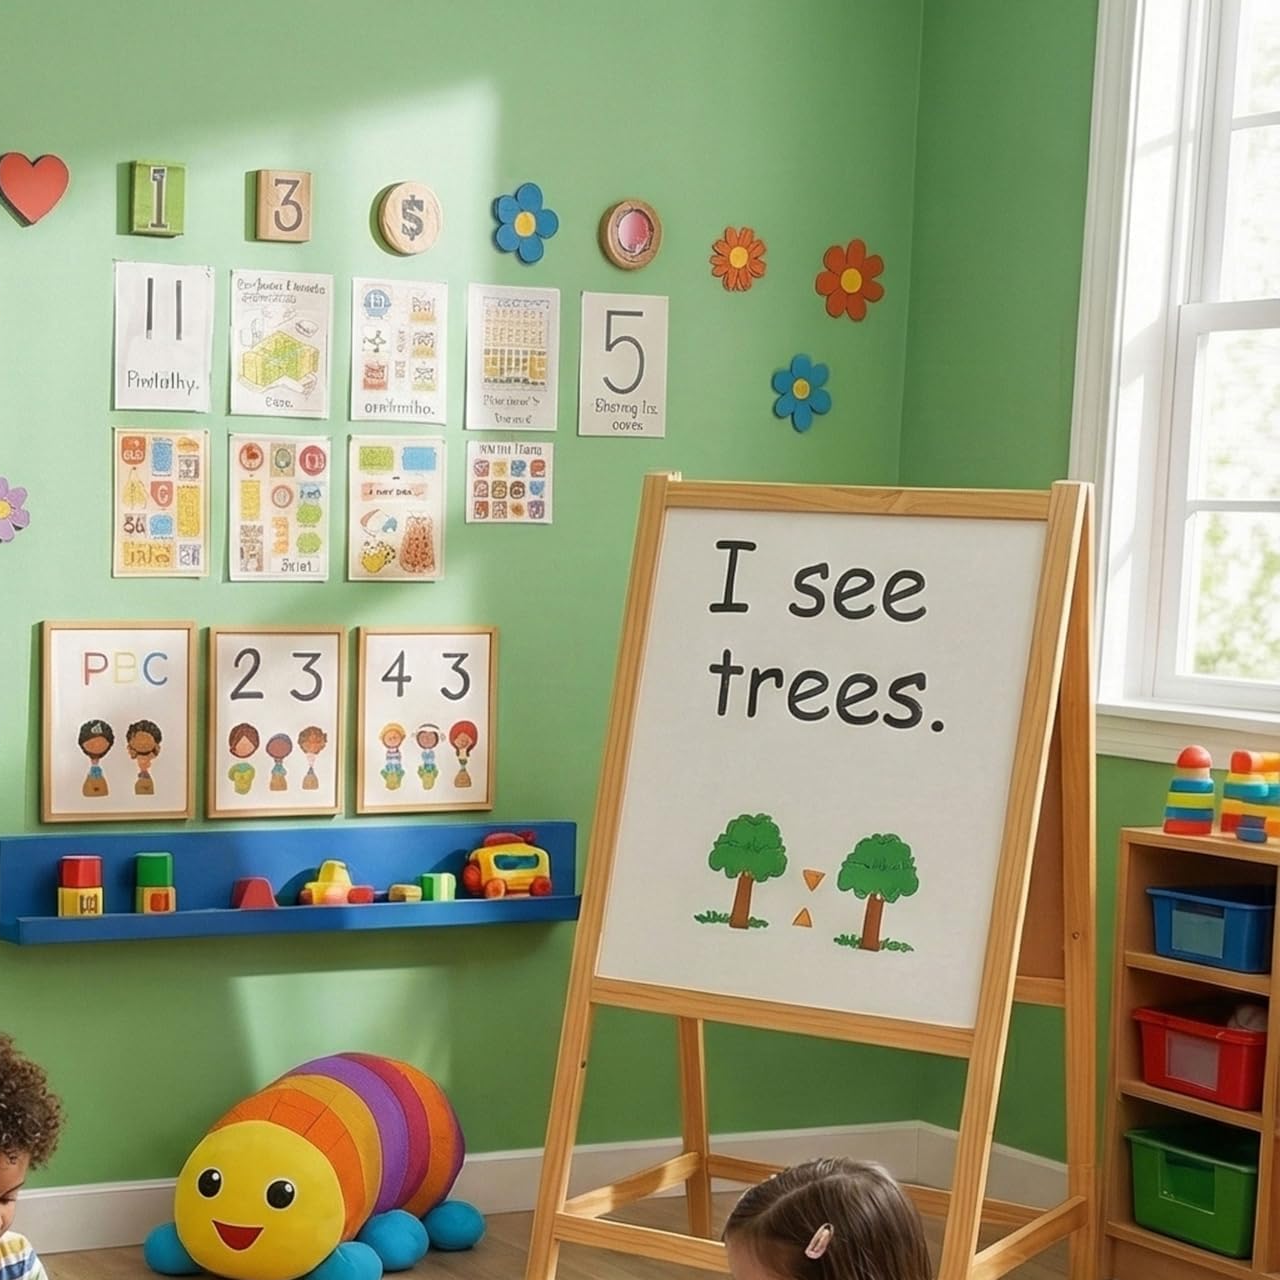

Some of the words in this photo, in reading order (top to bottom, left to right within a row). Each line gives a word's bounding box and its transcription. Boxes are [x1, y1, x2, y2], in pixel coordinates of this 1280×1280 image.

[273, 178, 303, 232] 3
[603, 310, 644, 394] 5
[709, 540, 757, 614] I
[788, 562, 928, 623] see
[230, 647, 264, 701] 2
[289, 652, 322, 702] 3
[381, 650, 412, 698] 4
[440, 652, 471, 702] 3
[709, 649, 944, 734] trees.
